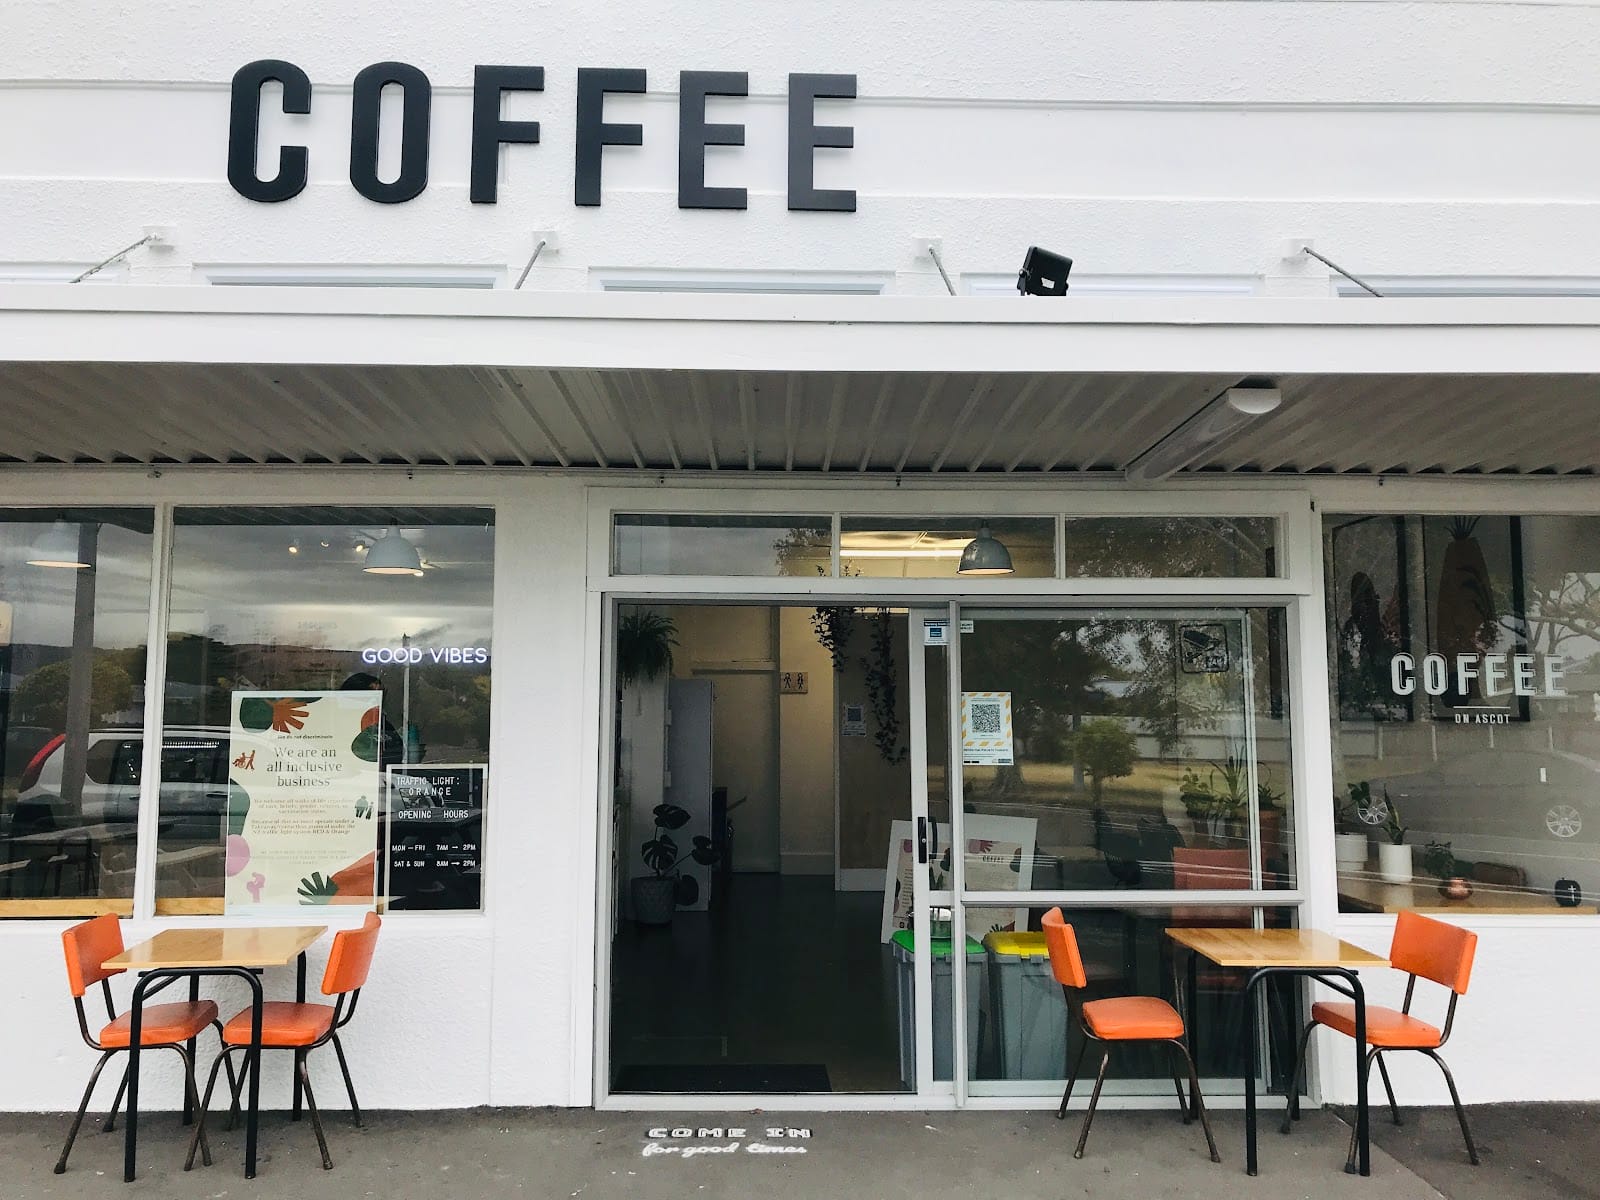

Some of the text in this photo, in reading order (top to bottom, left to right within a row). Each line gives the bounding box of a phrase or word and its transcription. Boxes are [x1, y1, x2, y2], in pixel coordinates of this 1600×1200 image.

[227, 59, 857, 212] COFFEE
[362, 647, 488, 664] GOOD VIBES
[1390, 652, 1568, 697] COFFEE
[1455, 713, 1510, 724] ON ASCOT
[274, 747, 337, 758] We are an
[266, 761, 343, 772] all inclusive
[277, 775, 331, 787] business
[397, 776, 428, 786] TRAFFIC
[408, 786, 452, 796] ORANGE
[398, 809, 469, 819] OPENING HOURS
[391, 844, 406, 852] MON
[462, 843, 476, 851] 2PM
[394, 860, 404, 868] SAT
[413, 860, 425, 868] SUN
[462, 860, 476, 868] 2PM
[646, 1127, 813, 1139] COME IN
[642, 1142, 680, 1157] for
[681, 1142, 740, 1159] good
